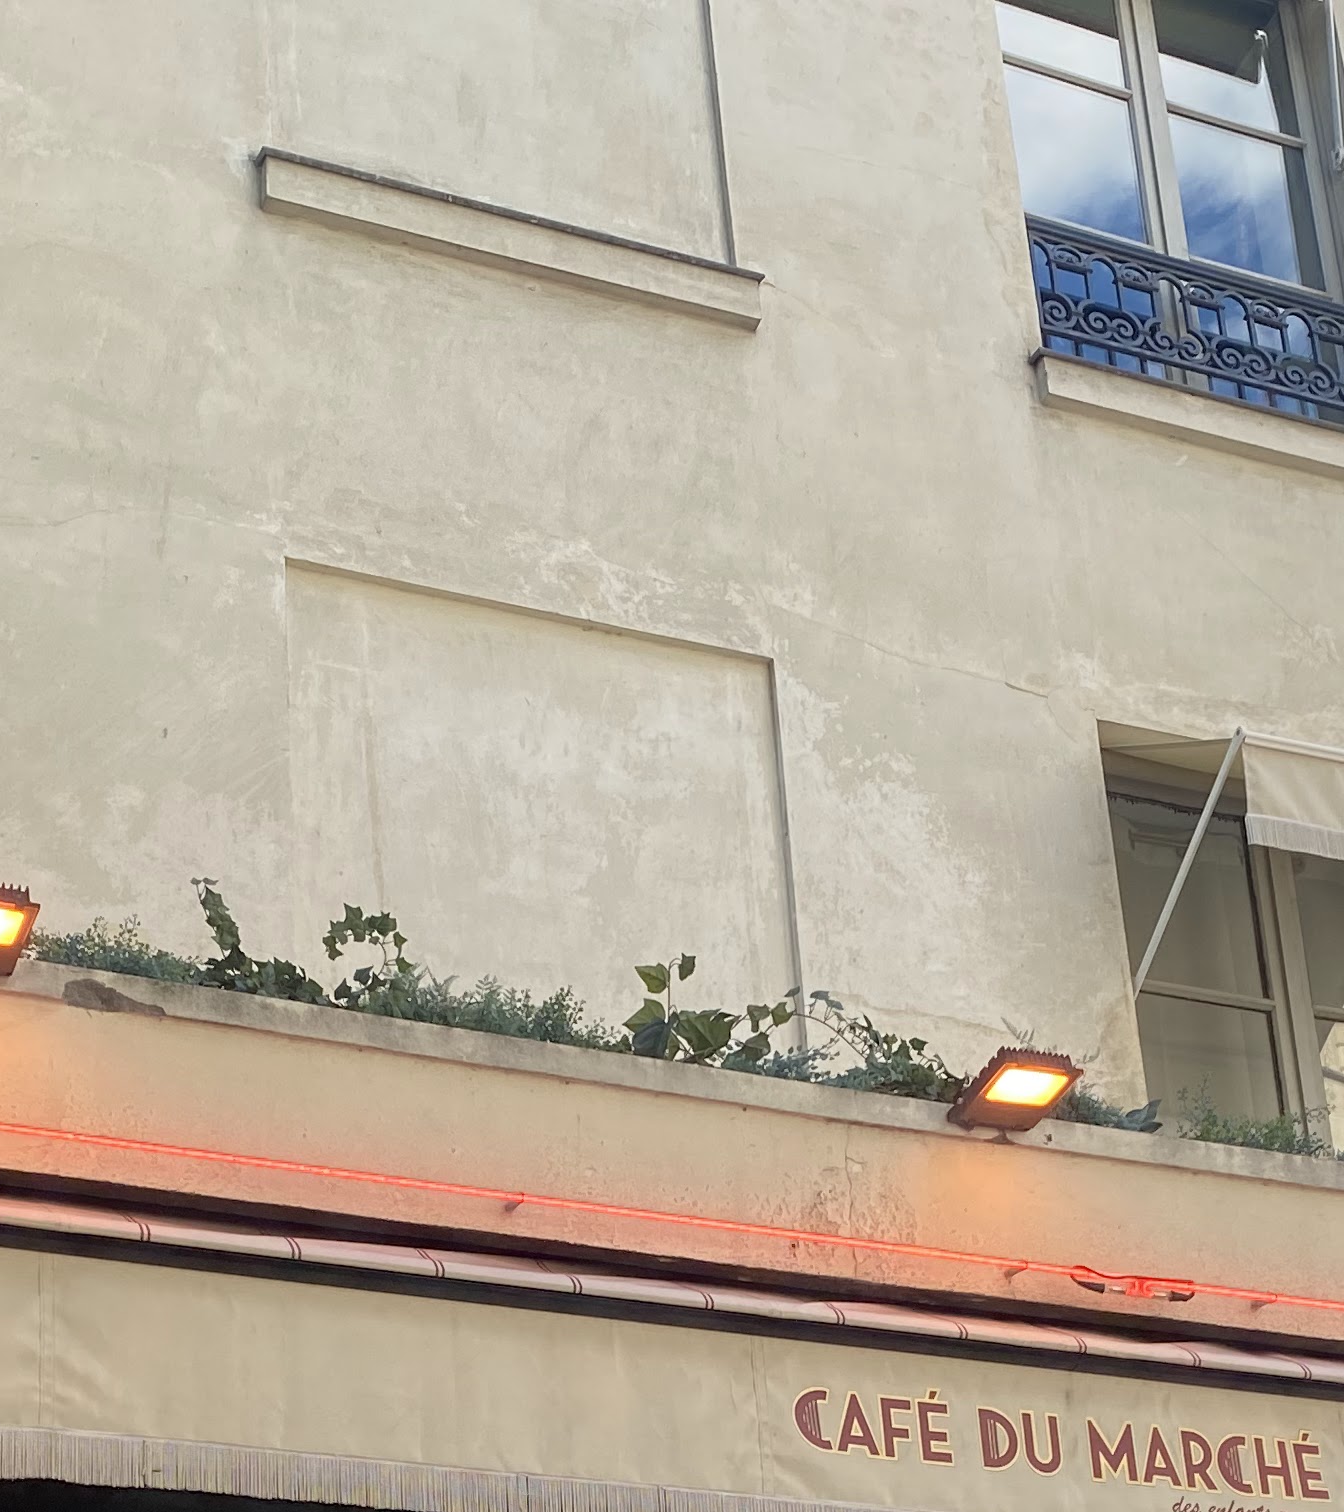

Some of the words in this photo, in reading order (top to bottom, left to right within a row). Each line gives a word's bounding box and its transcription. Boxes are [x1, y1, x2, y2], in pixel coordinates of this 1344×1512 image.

[792, 1386, 955, 1467] CAFÉ
[976, 1406, 1062, 1477] DU
[1085, 1416, 1331, 1502] MARCHÉ
